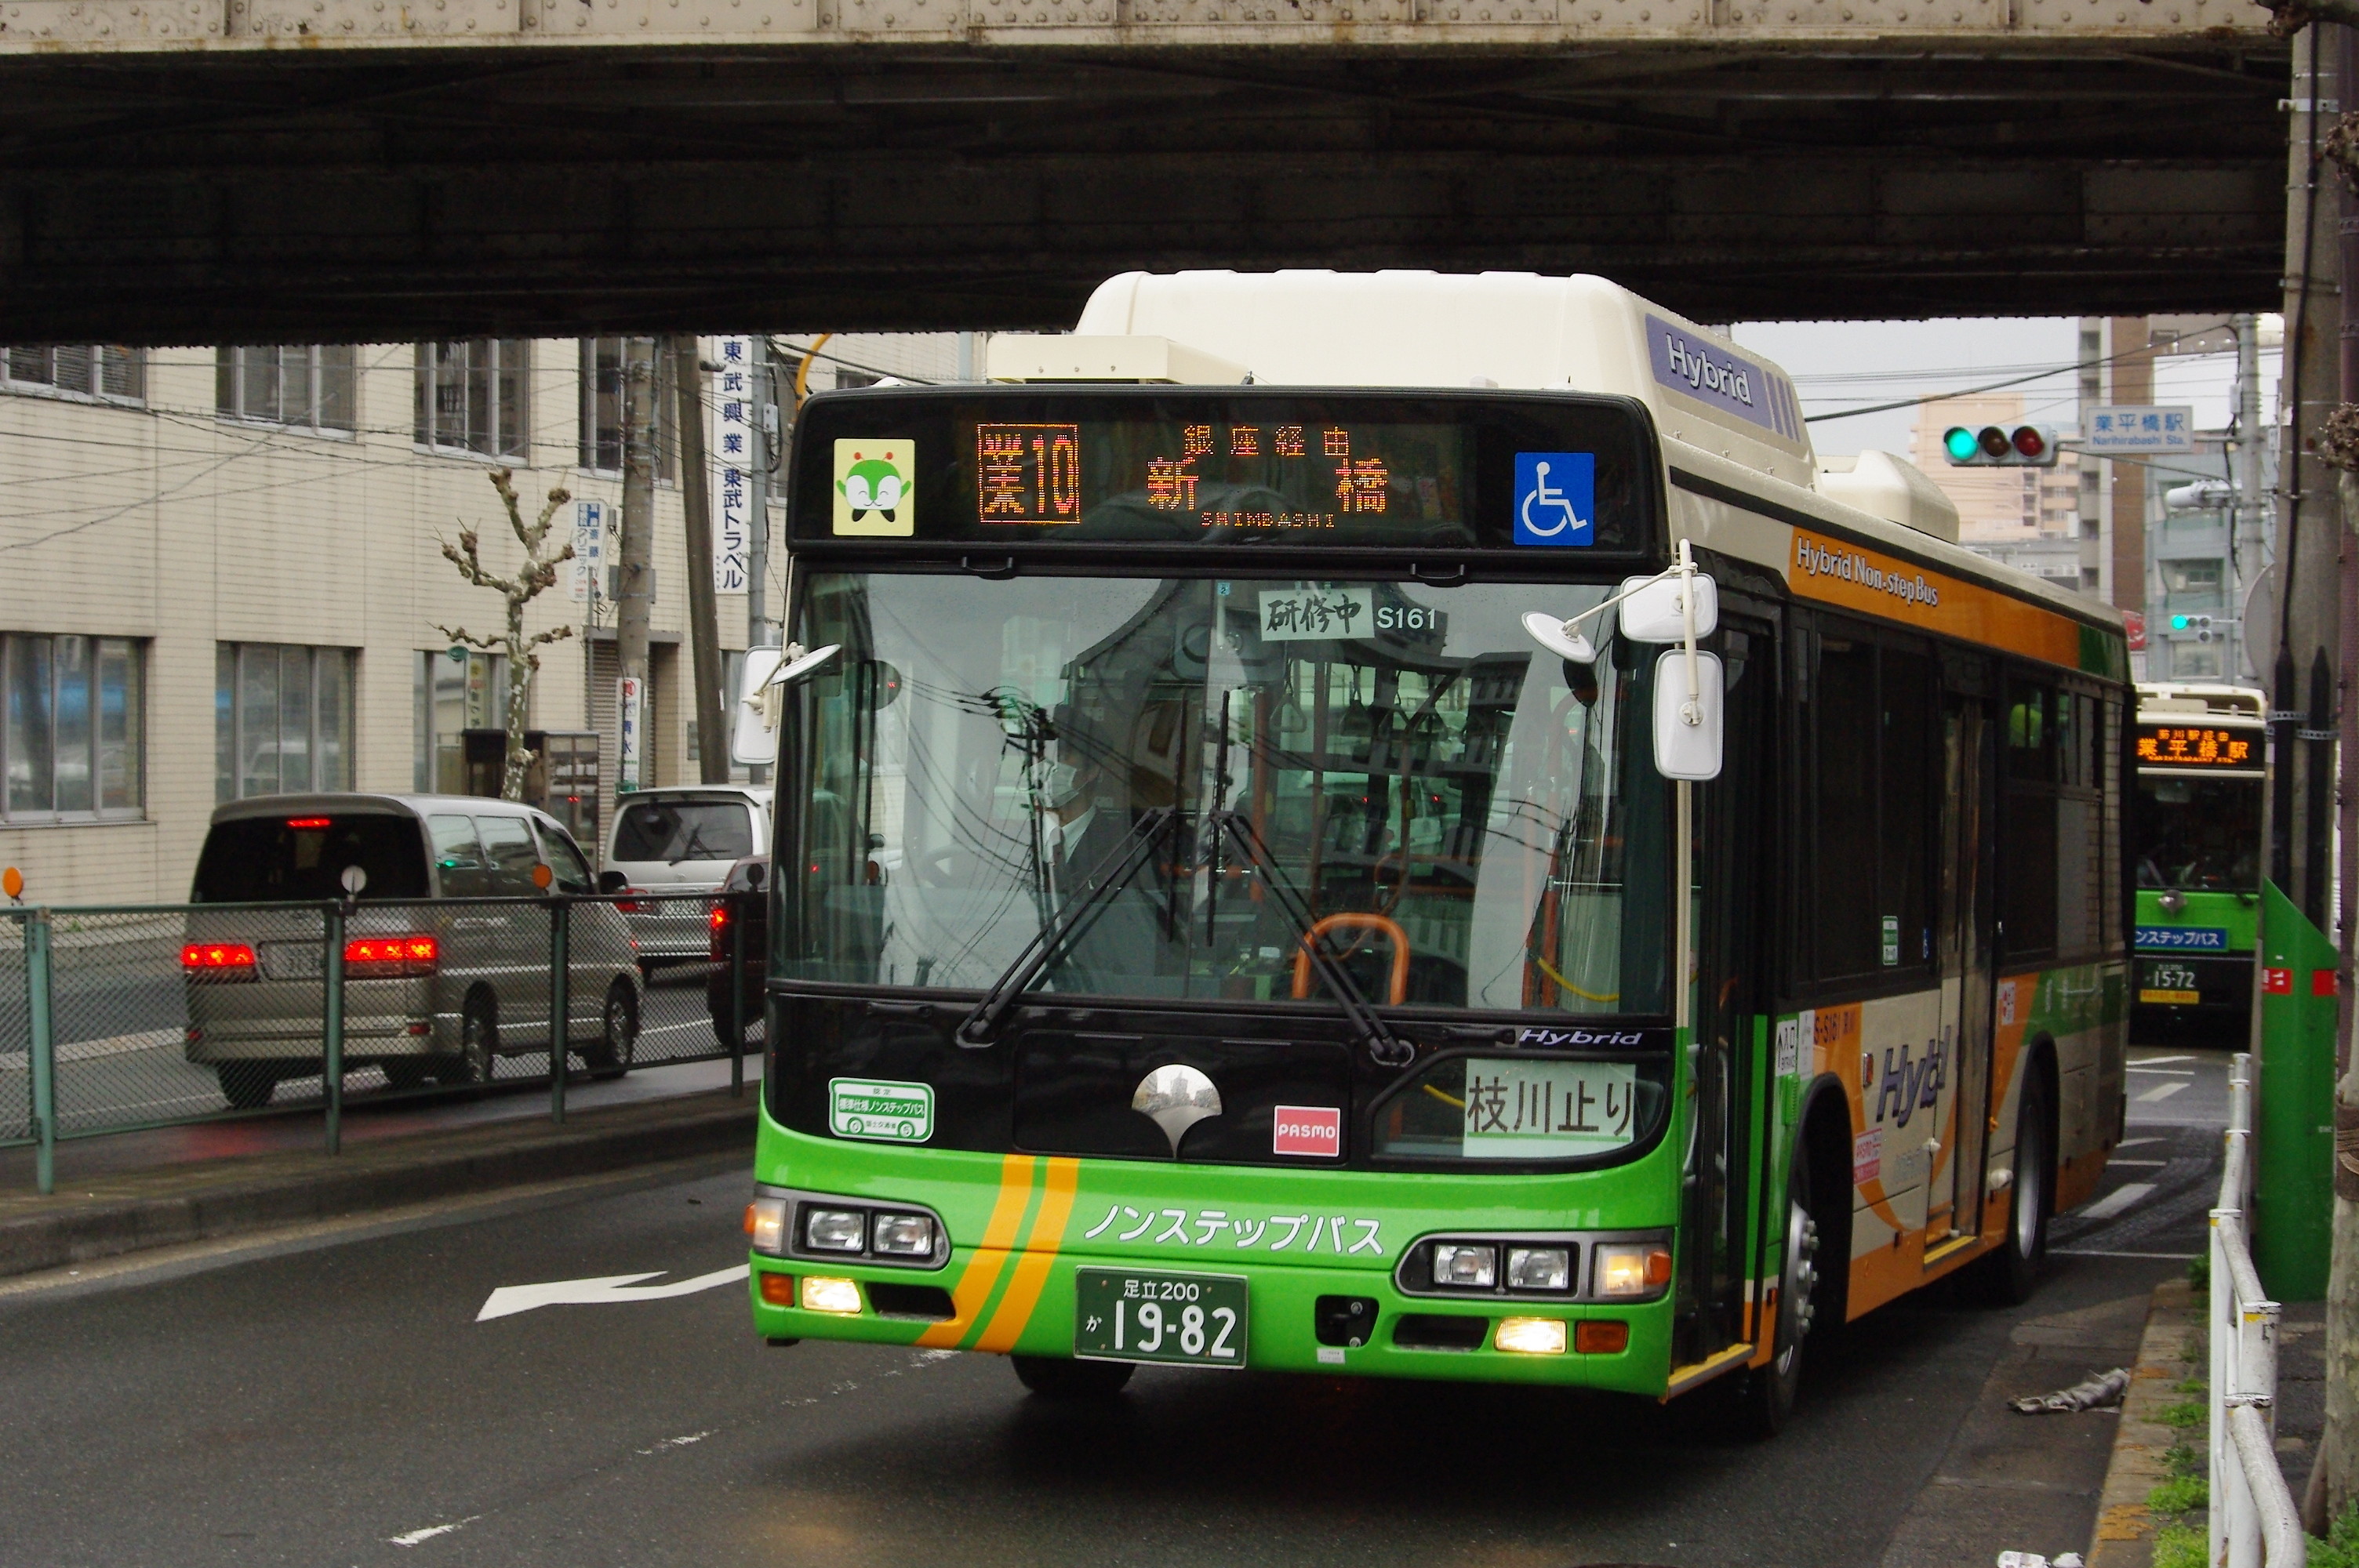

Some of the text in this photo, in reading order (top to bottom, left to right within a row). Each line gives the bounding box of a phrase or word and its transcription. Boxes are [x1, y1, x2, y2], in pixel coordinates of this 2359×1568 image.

[1666, 332, 1754, 407] Hybrid
[723, 341, 743, 454] 東武興業
[1184, 425, 1350, 456] 銀座経由
[2092, 435, 2161, 445] Narihirabashi
[2095, 413, 2185, 432] 業平橋駅
[1147, 456, 1388, 512] 新橋
[723, 469, 743, 589] 東武トラベル
[1200, 512, 1335, 528] SHIMBASHI
[1797, 536, 1852, 580] Hybrid
[1916, 574, 1939, 607] Bus
[1266, 593, 1361, 634] 研修中
[1376, 607, 1435, 630] S161
[2154, 971, 2196, 988] 15-72
[1519, 1028, 1643, 1047] Hybrid
[1467, 1076, 1634, 1137] 枝川止り
[1278, 1123, 1336, 1139] PASMO
[1084, 1204, 1383, 1254] ノンステップバス
[1123, 1279, 1200, 1301] 足立200
[1114, 1300, 1237, 1358] 19-82
